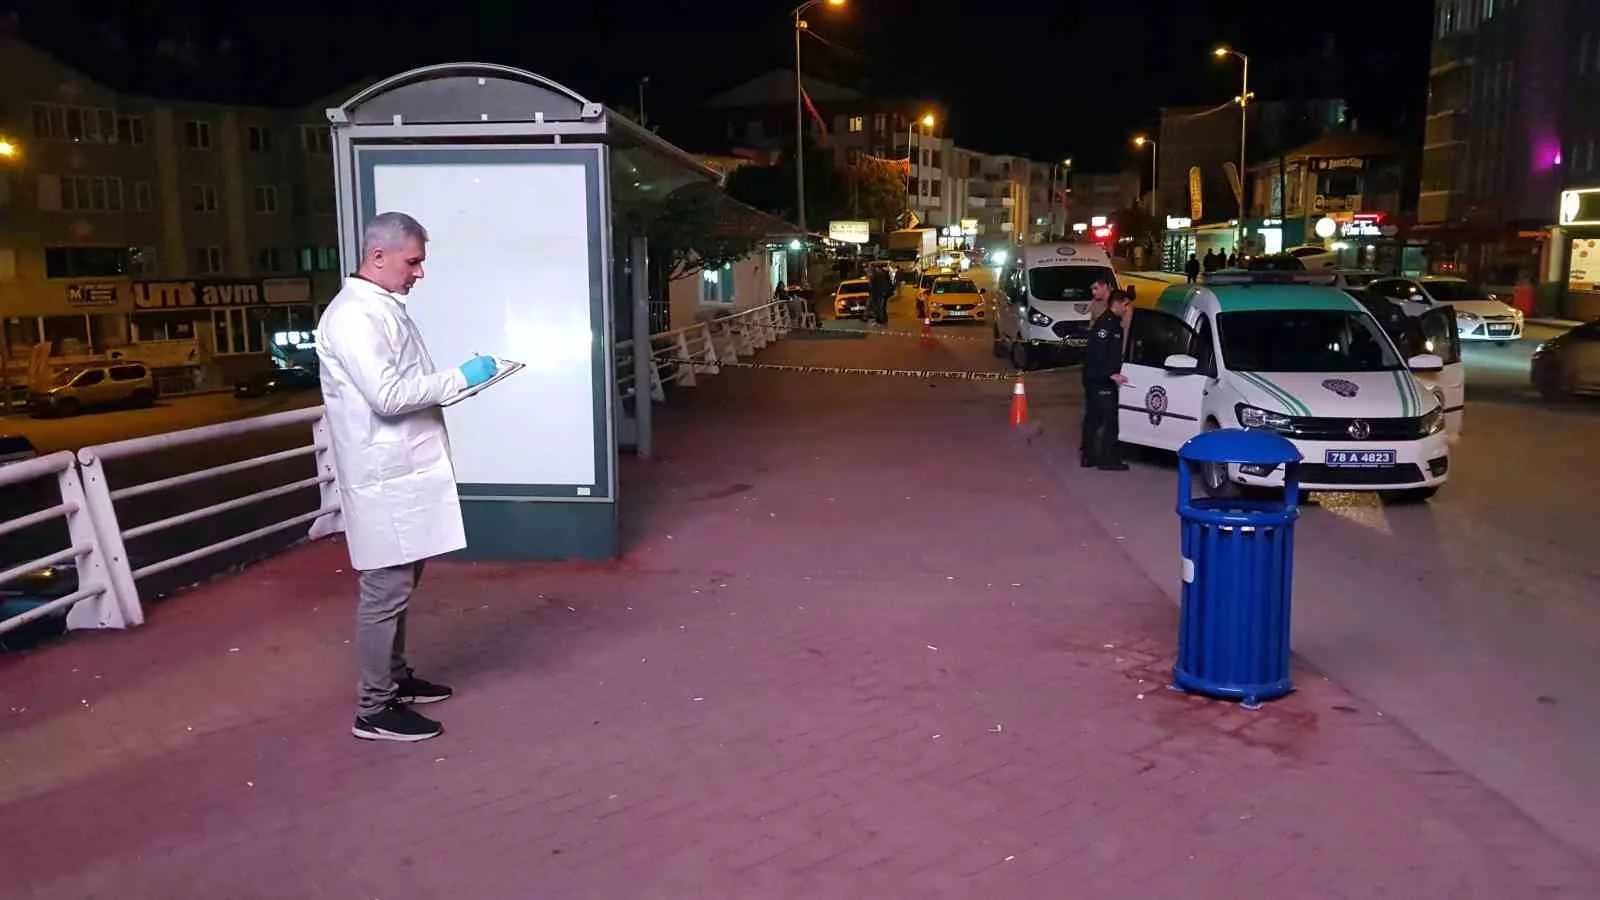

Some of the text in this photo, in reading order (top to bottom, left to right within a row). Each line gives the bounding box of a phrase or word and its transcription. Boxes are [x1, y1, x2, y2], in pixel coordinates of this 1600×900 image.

[202, 284, 259, 305] avm
[1332, 453, 1389, 462] 78 A 4823
